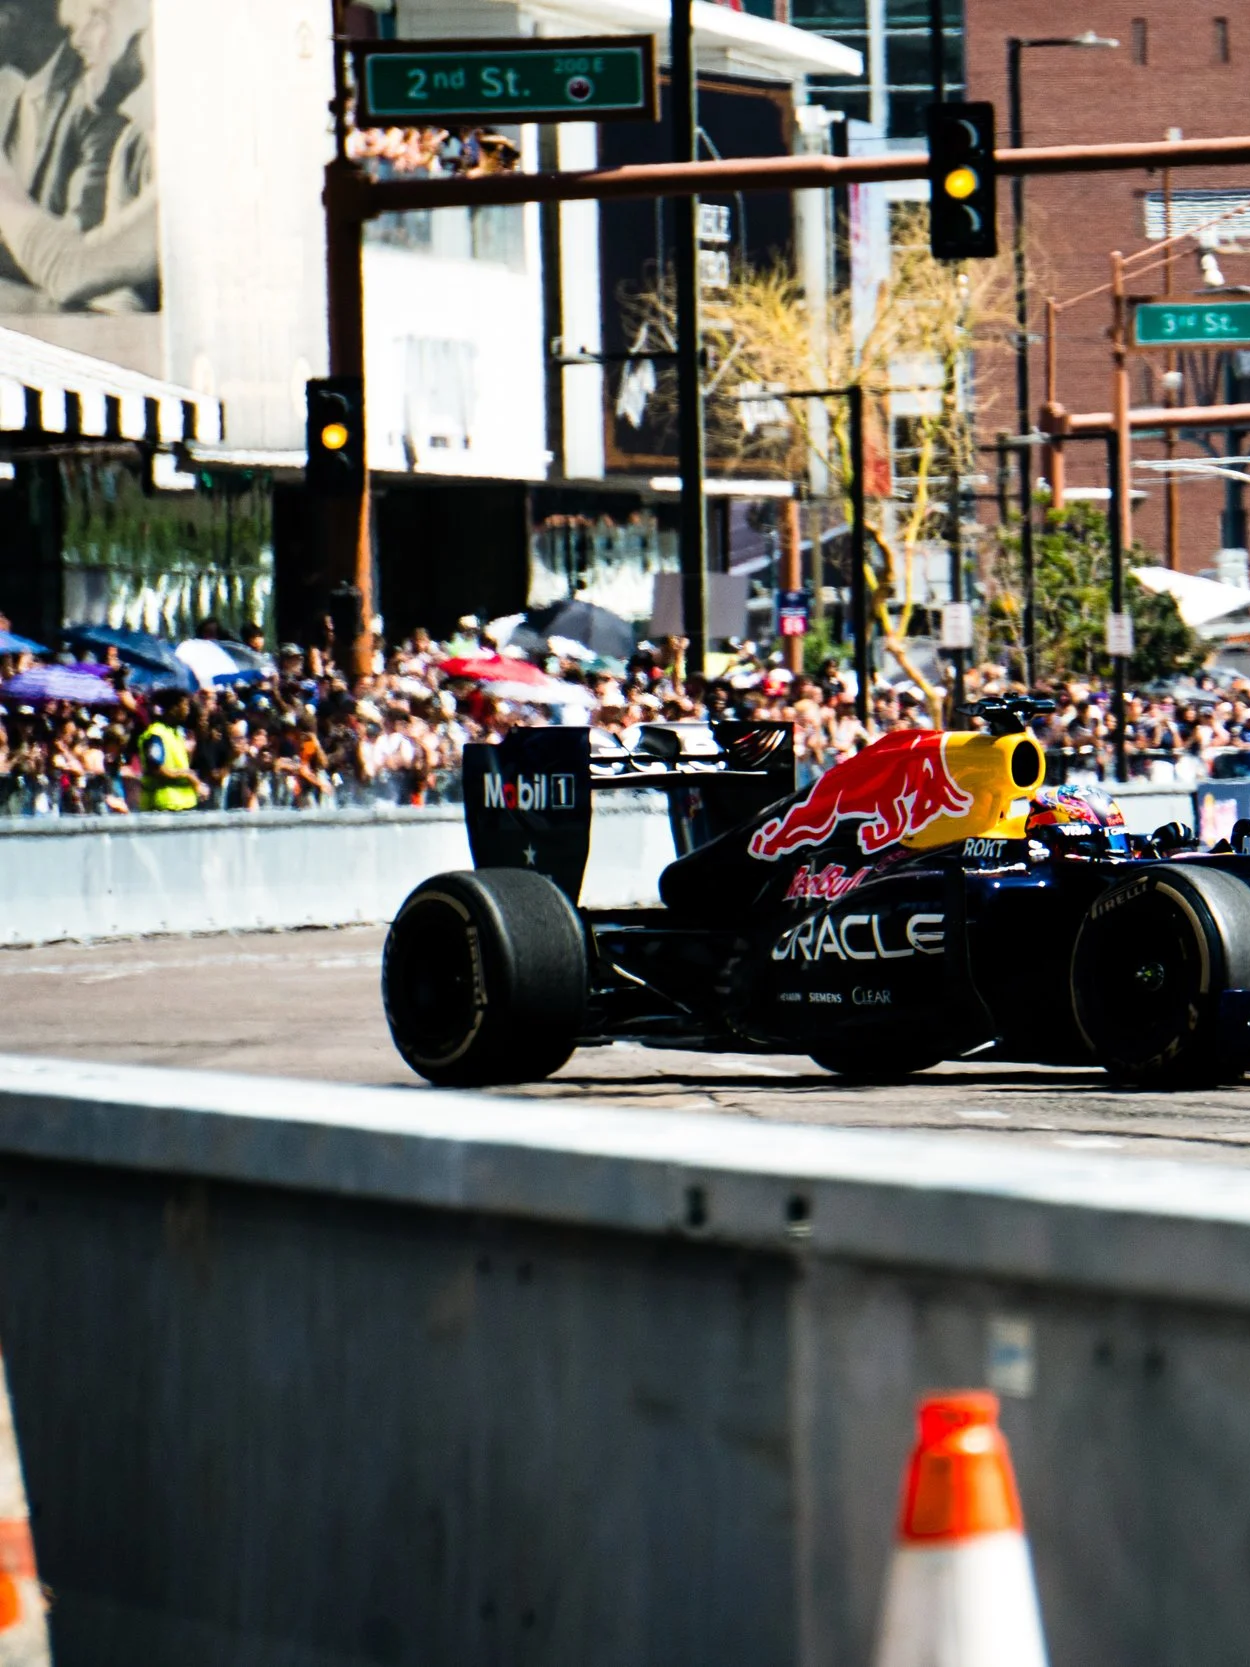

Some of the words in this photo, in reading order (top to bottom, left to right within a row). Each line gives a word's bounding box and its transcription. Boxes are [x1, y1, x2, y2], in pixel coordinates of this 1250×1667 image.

[406, 67, 465, 99] 2nd
[480, 67, 531, 98] St.
[1161, 312, 1197, 335] 3rd
[1204, 312, 1239, 335] St.
[484, 772, 547, 811] Mobil
[962, 838, 1008, 859] ROKT
[808, 991, 843, 1004] SIEMENS
